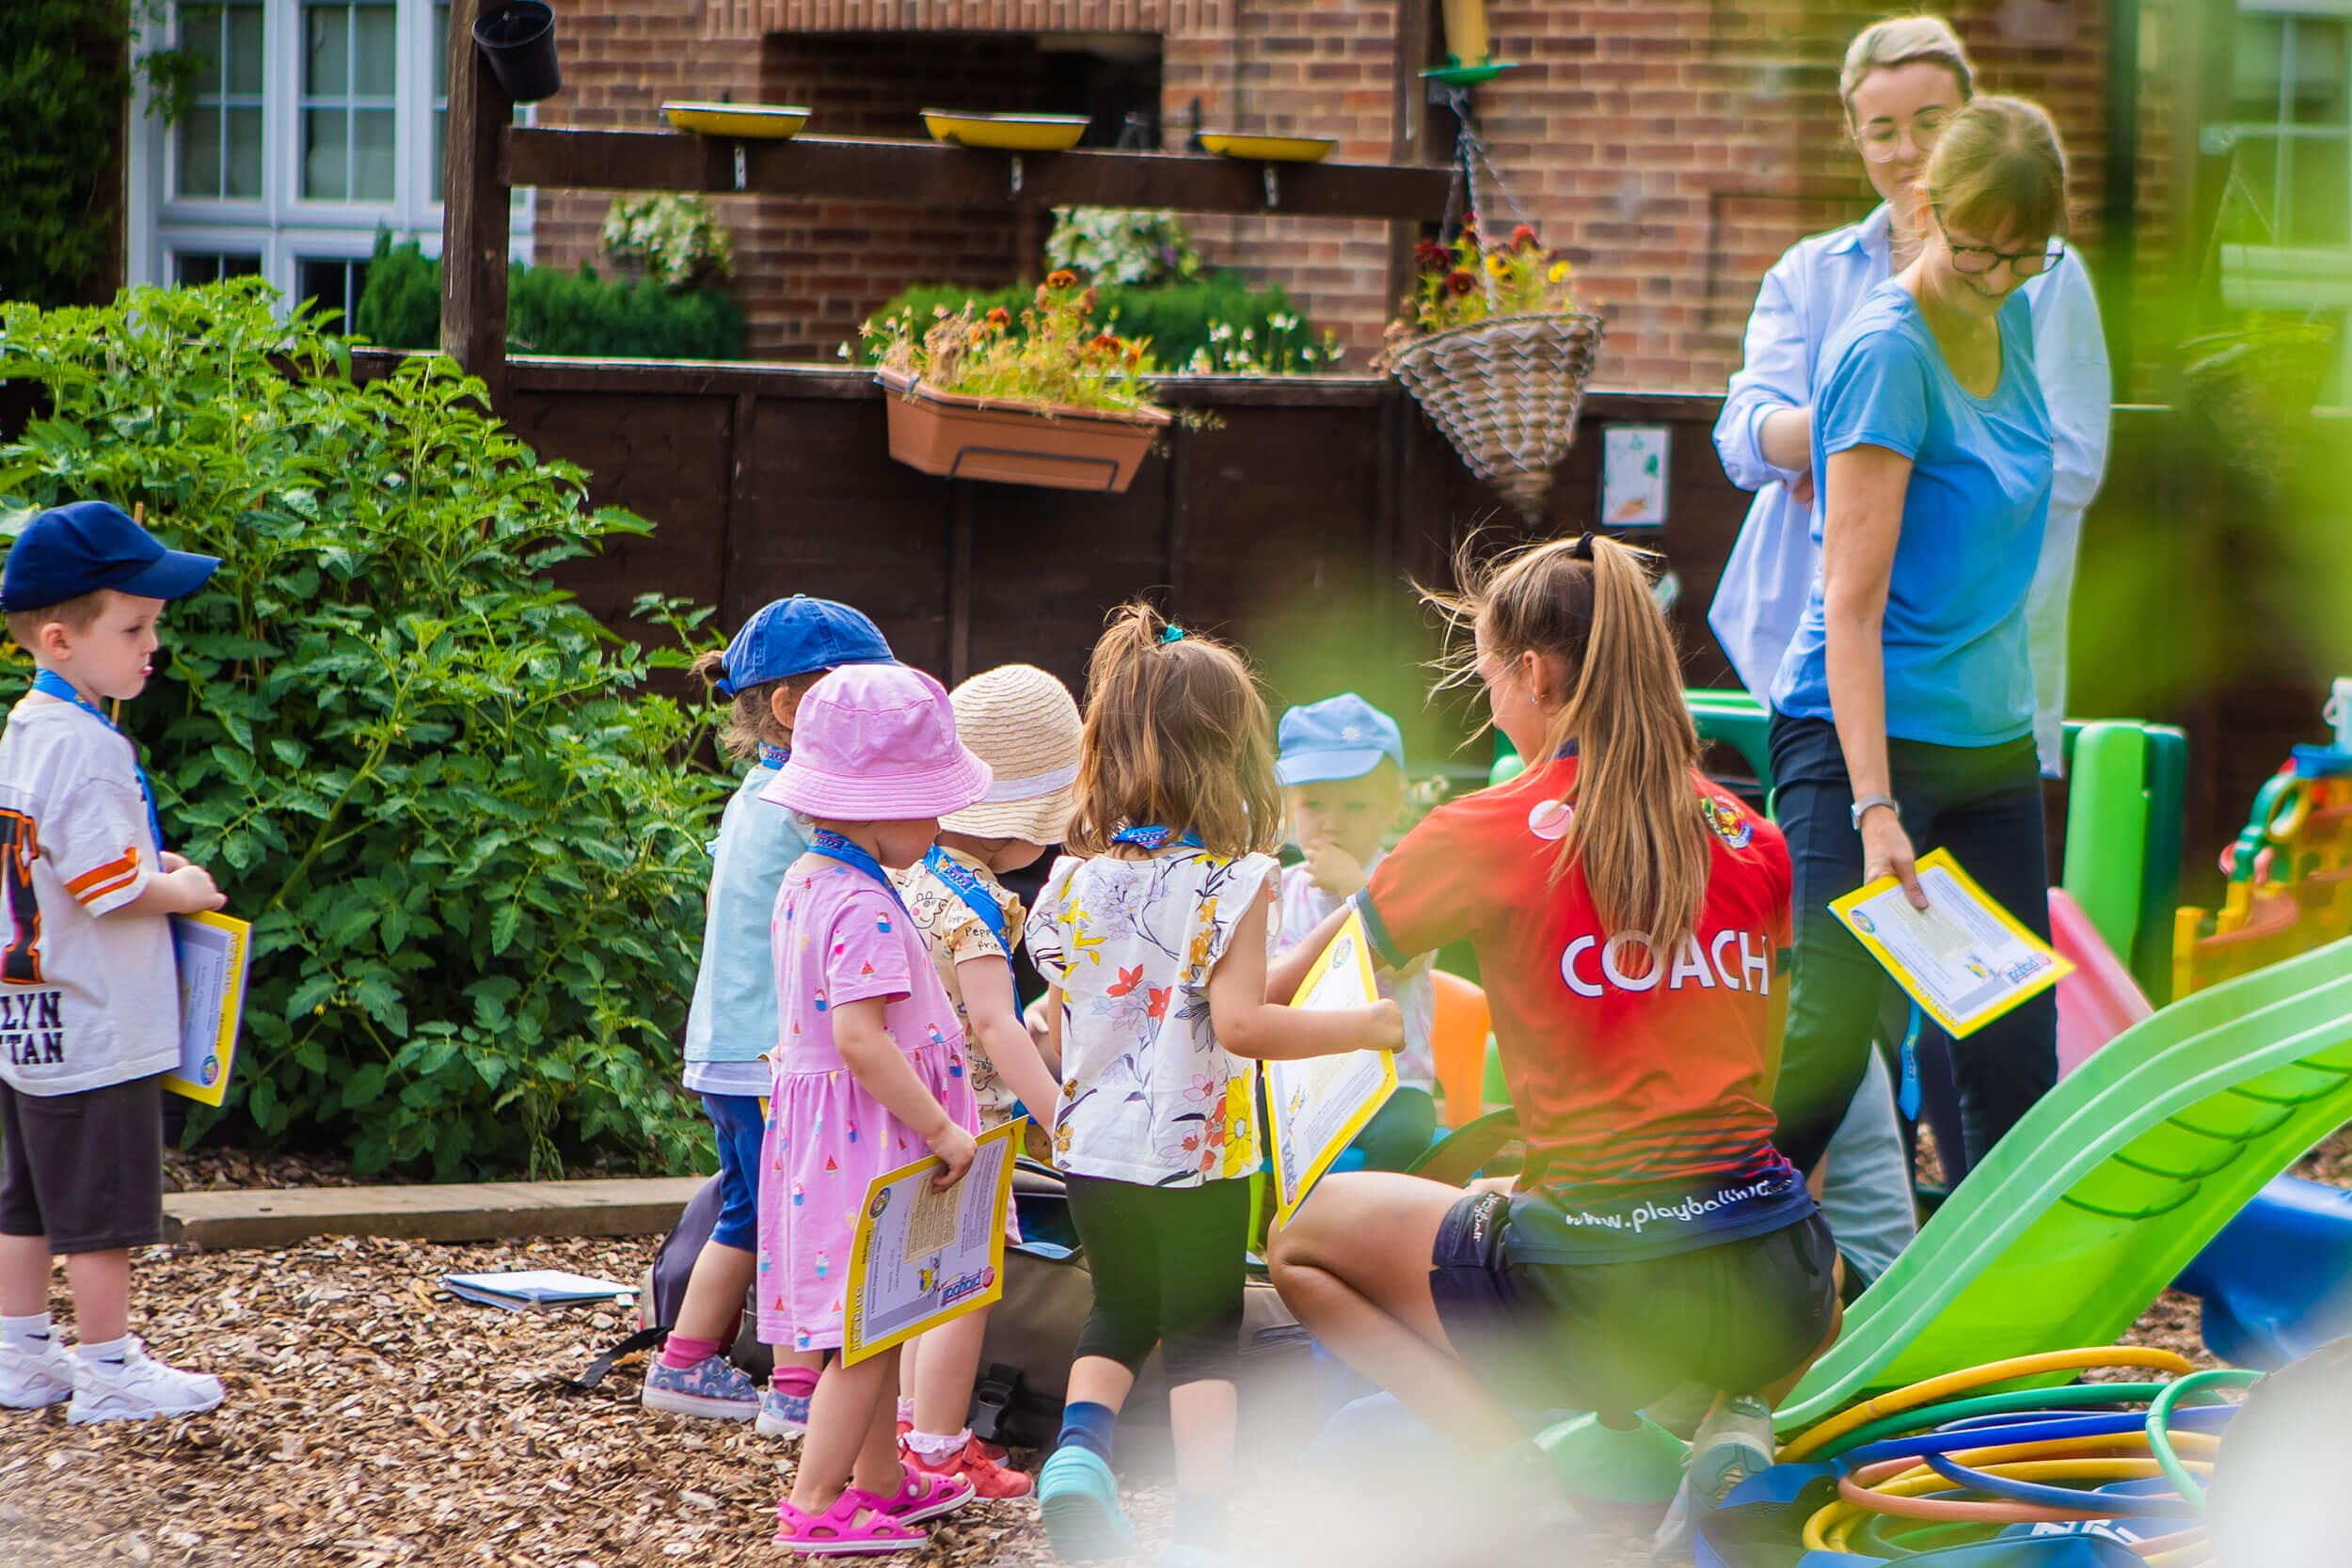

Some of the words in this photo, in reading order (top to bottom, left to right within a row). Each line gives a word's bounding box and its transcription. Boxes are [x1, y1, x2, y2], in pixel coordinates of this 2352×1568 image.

[965, 927, 994, 939] Pepp
[978, 942, 1002, 952] frie
[1560, 929, 1769, 998] COACH
[0, 1032, 64, 1065] TAN
